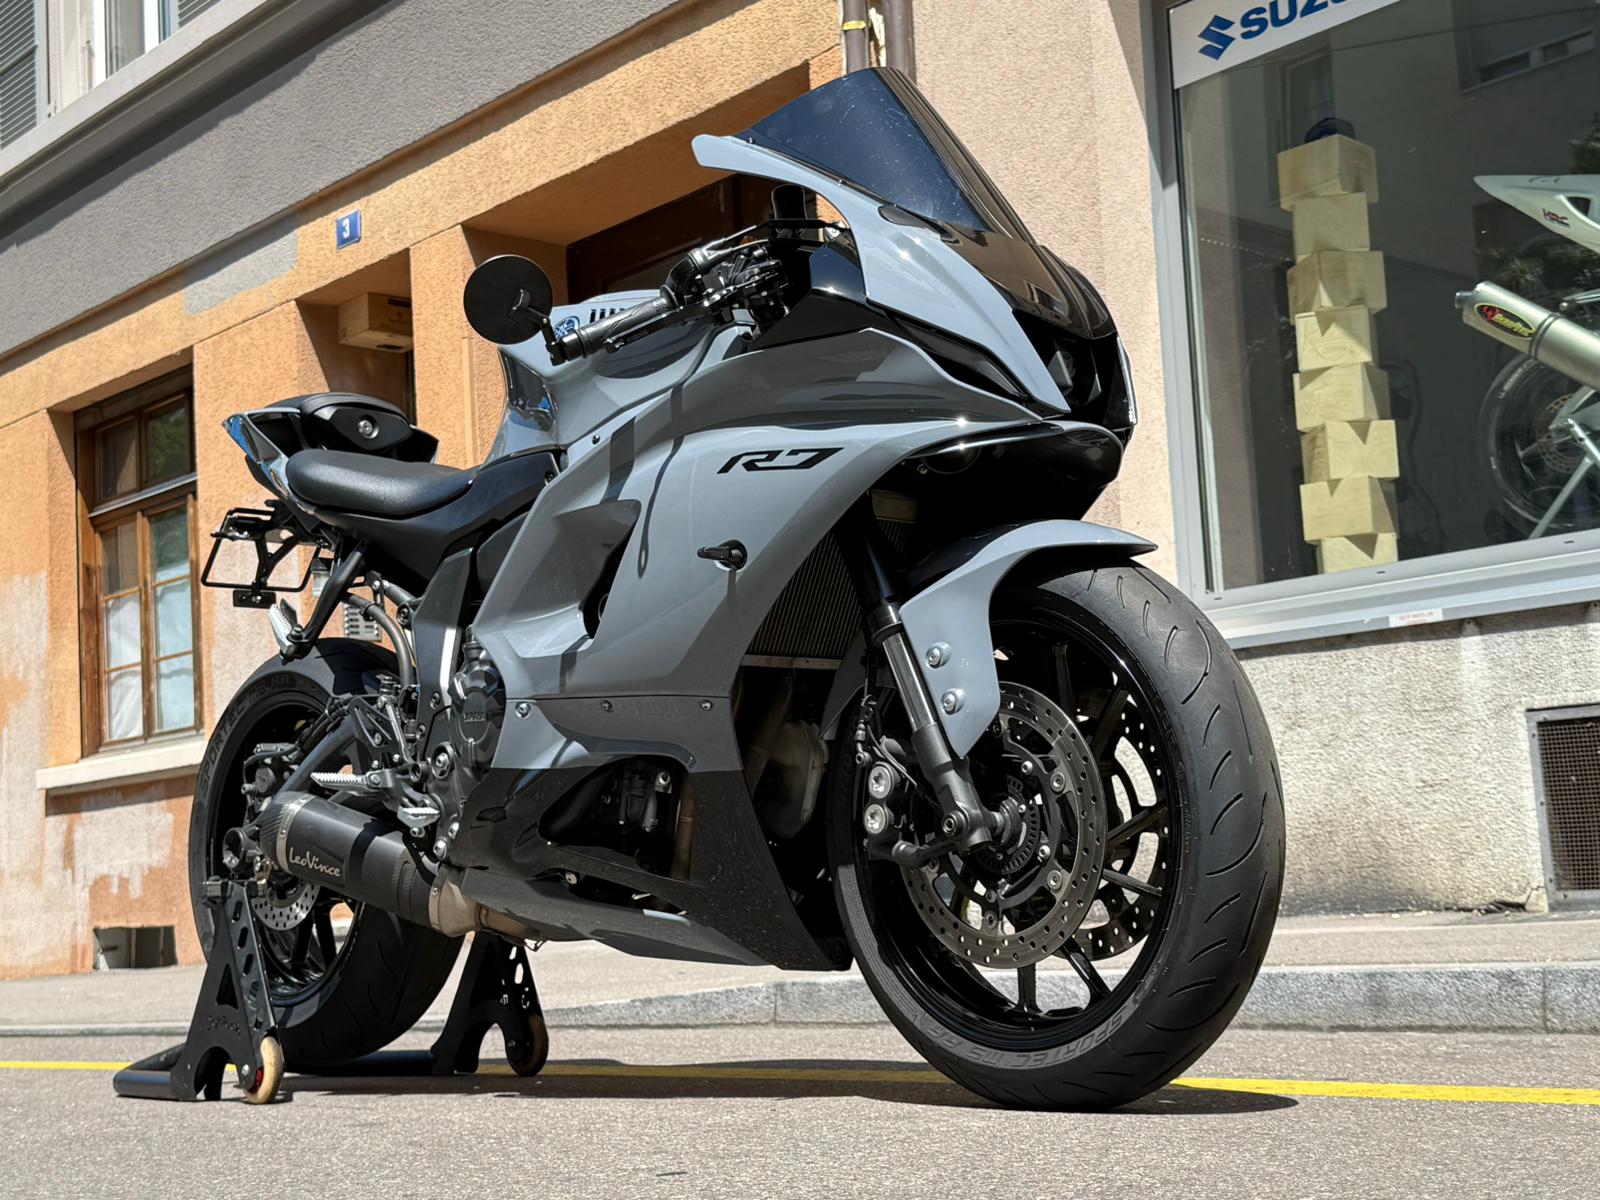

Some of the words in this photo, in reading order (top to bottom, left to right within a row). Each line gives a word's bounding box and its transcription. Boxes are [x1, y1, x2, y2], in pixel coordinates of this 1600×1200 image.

[1240, 0, 1348, 39] SUZ
[342, 218, 350, 239] 3
[716, 447, 845, 474] R7
[289, 846, 341, 877] LeoVince
[1010, 1007, 1127, 1068] SPORTEC
